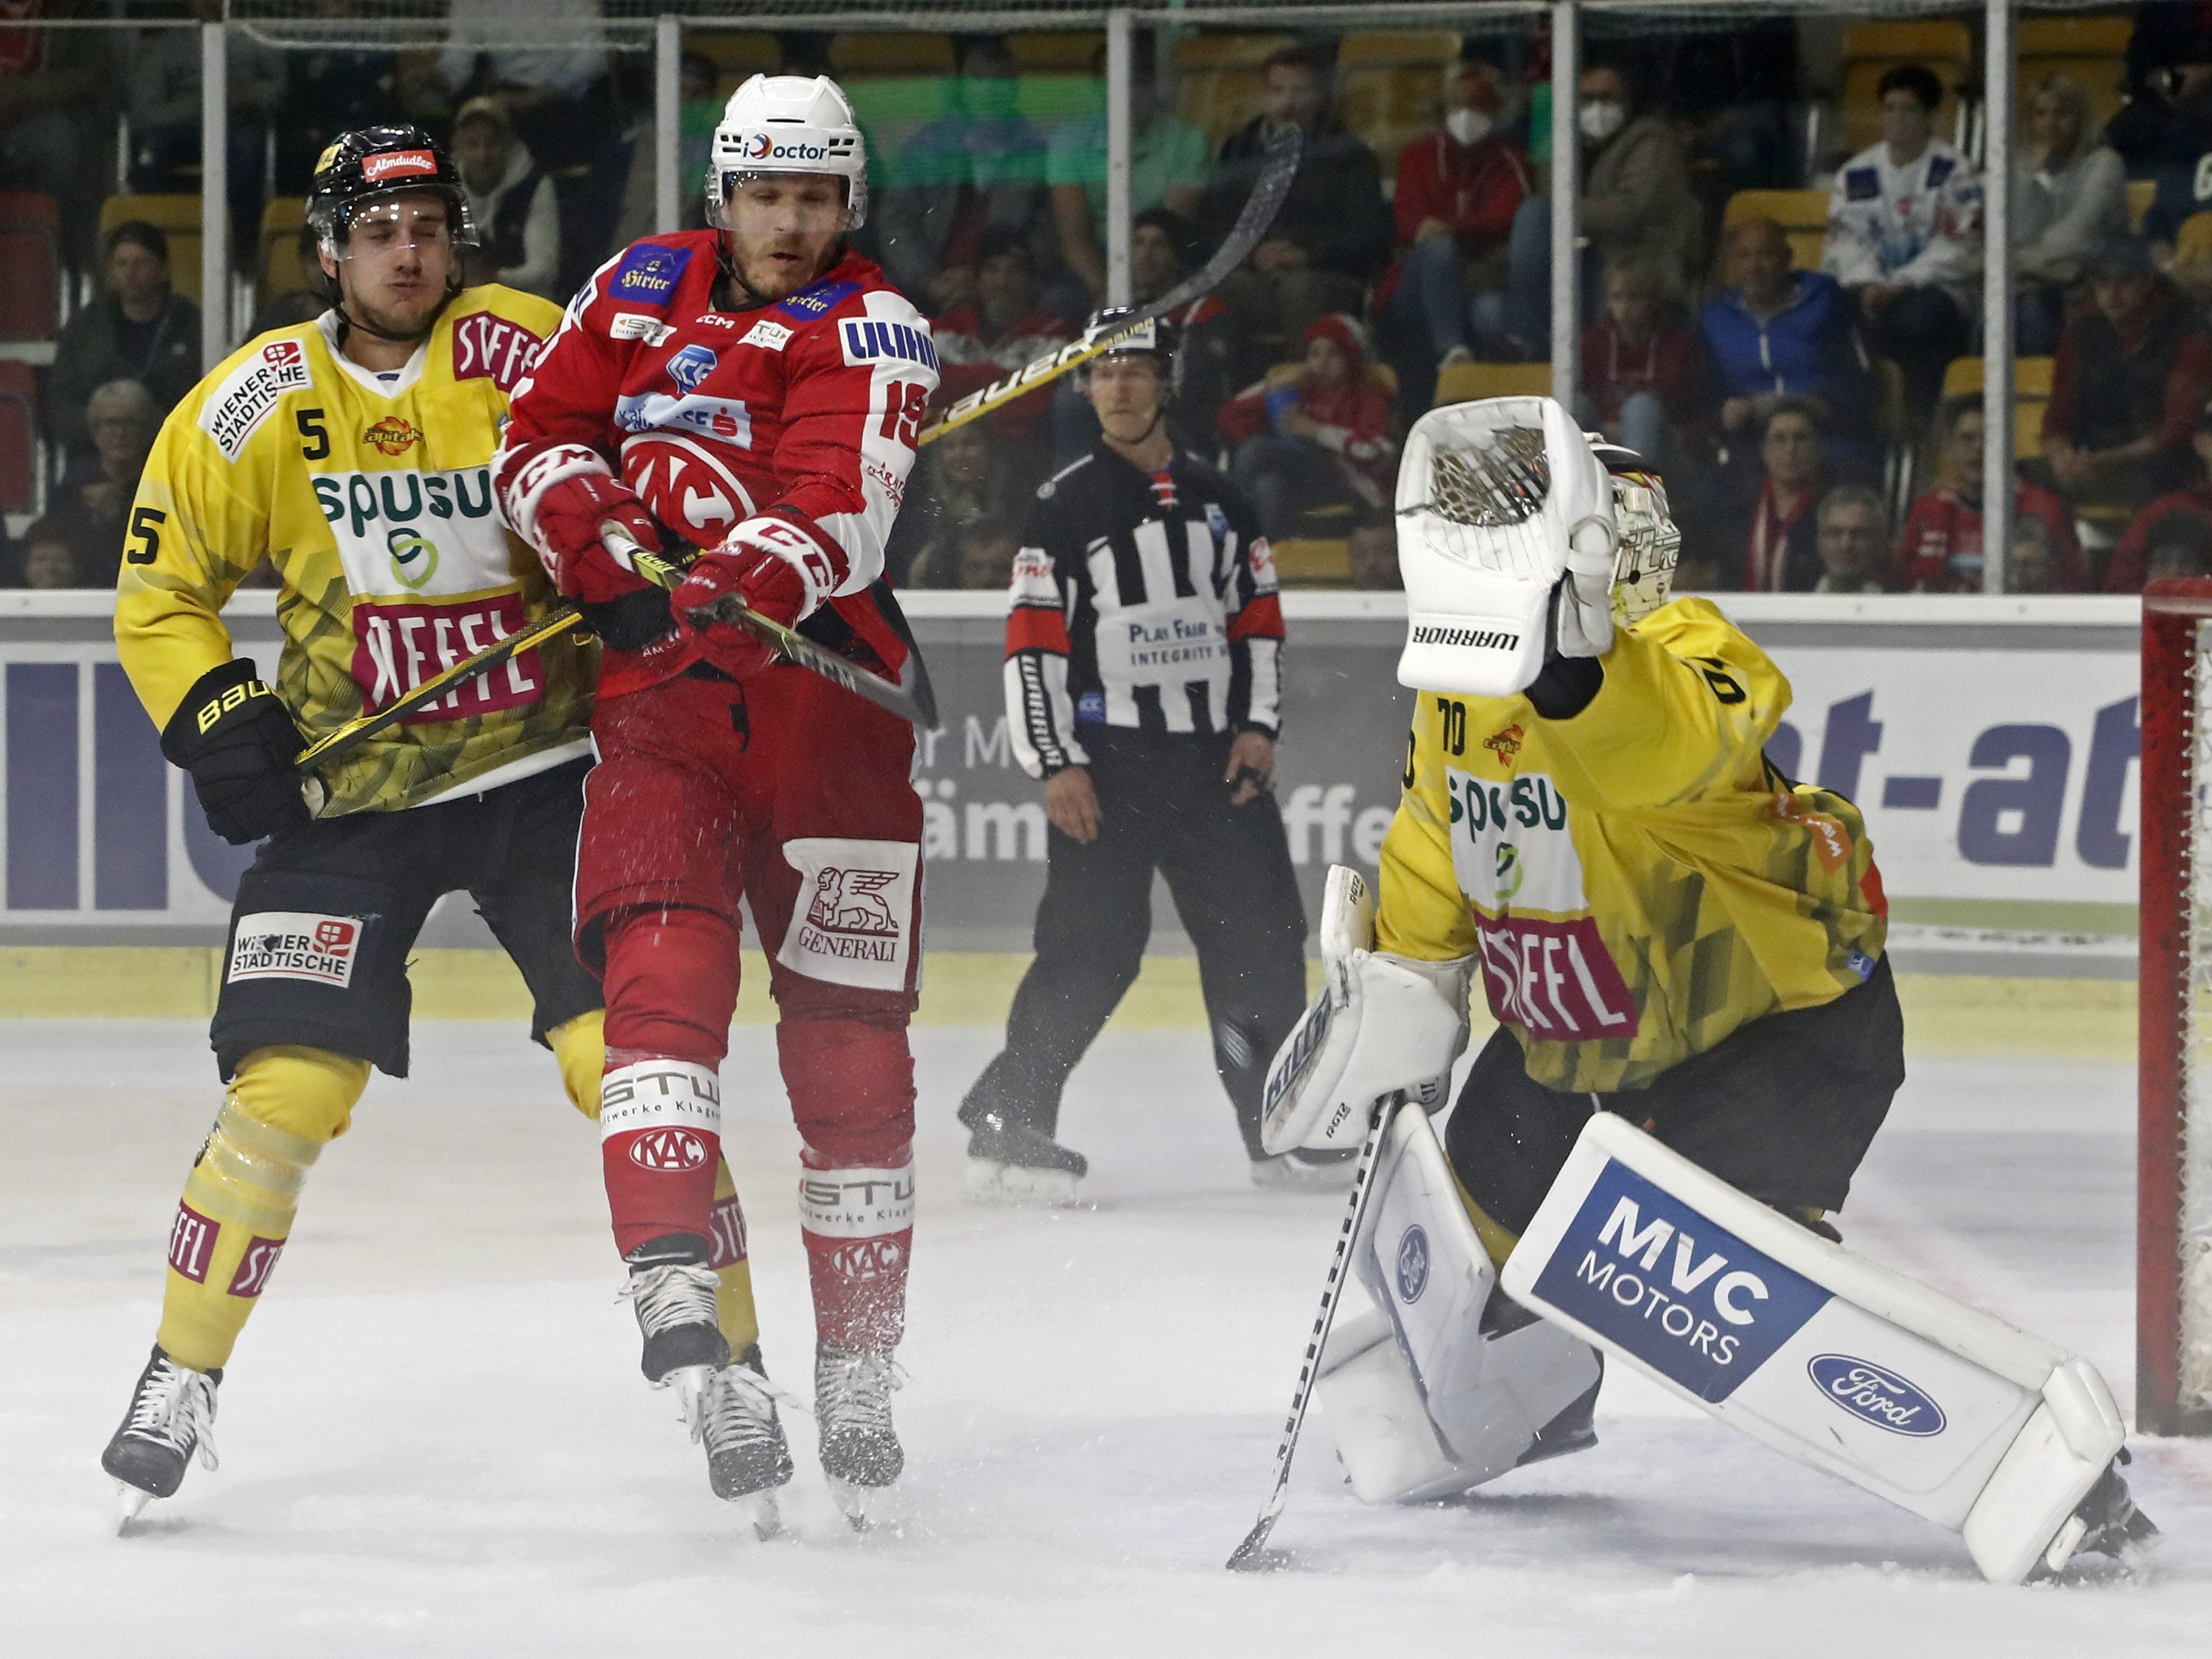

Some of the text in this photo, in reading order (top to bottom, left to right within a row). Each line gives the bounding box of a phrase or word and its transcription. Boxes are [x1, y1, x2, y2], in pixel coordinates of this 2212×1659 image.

[367, 155, 433, 177] Almdudler
[211, 368, 271, 436] WIENER
[942, 325, 1111, 423] AUER
[220, 365, 306, 452] STÄDTISHE
[296, 408, 330, 460] 5
[879, 380, 928, 453] 19
[312, 469, 492, 538] spusu
[127, 507, 166, 565] 5
[1412, 626, 1520, 651] WARRIOR
[197, 679, 276, 735] BAU
[1437, 698, 1466, 756] 70
[233, 951, 348, 977] STÄDTISCHE
[798, 925, 898, 963] GENERALI
[1477, 925, 1626, 1031] STFFL
[635, 1128, 704, 1171] KAC
[170, 1207, 208, 1278] FFL
[1598, 1195, 1769, 1326] MVC
[1576, 1250, 1741, 1366] MOTORS
[1831, 1368, 1922, 1426] Ford
